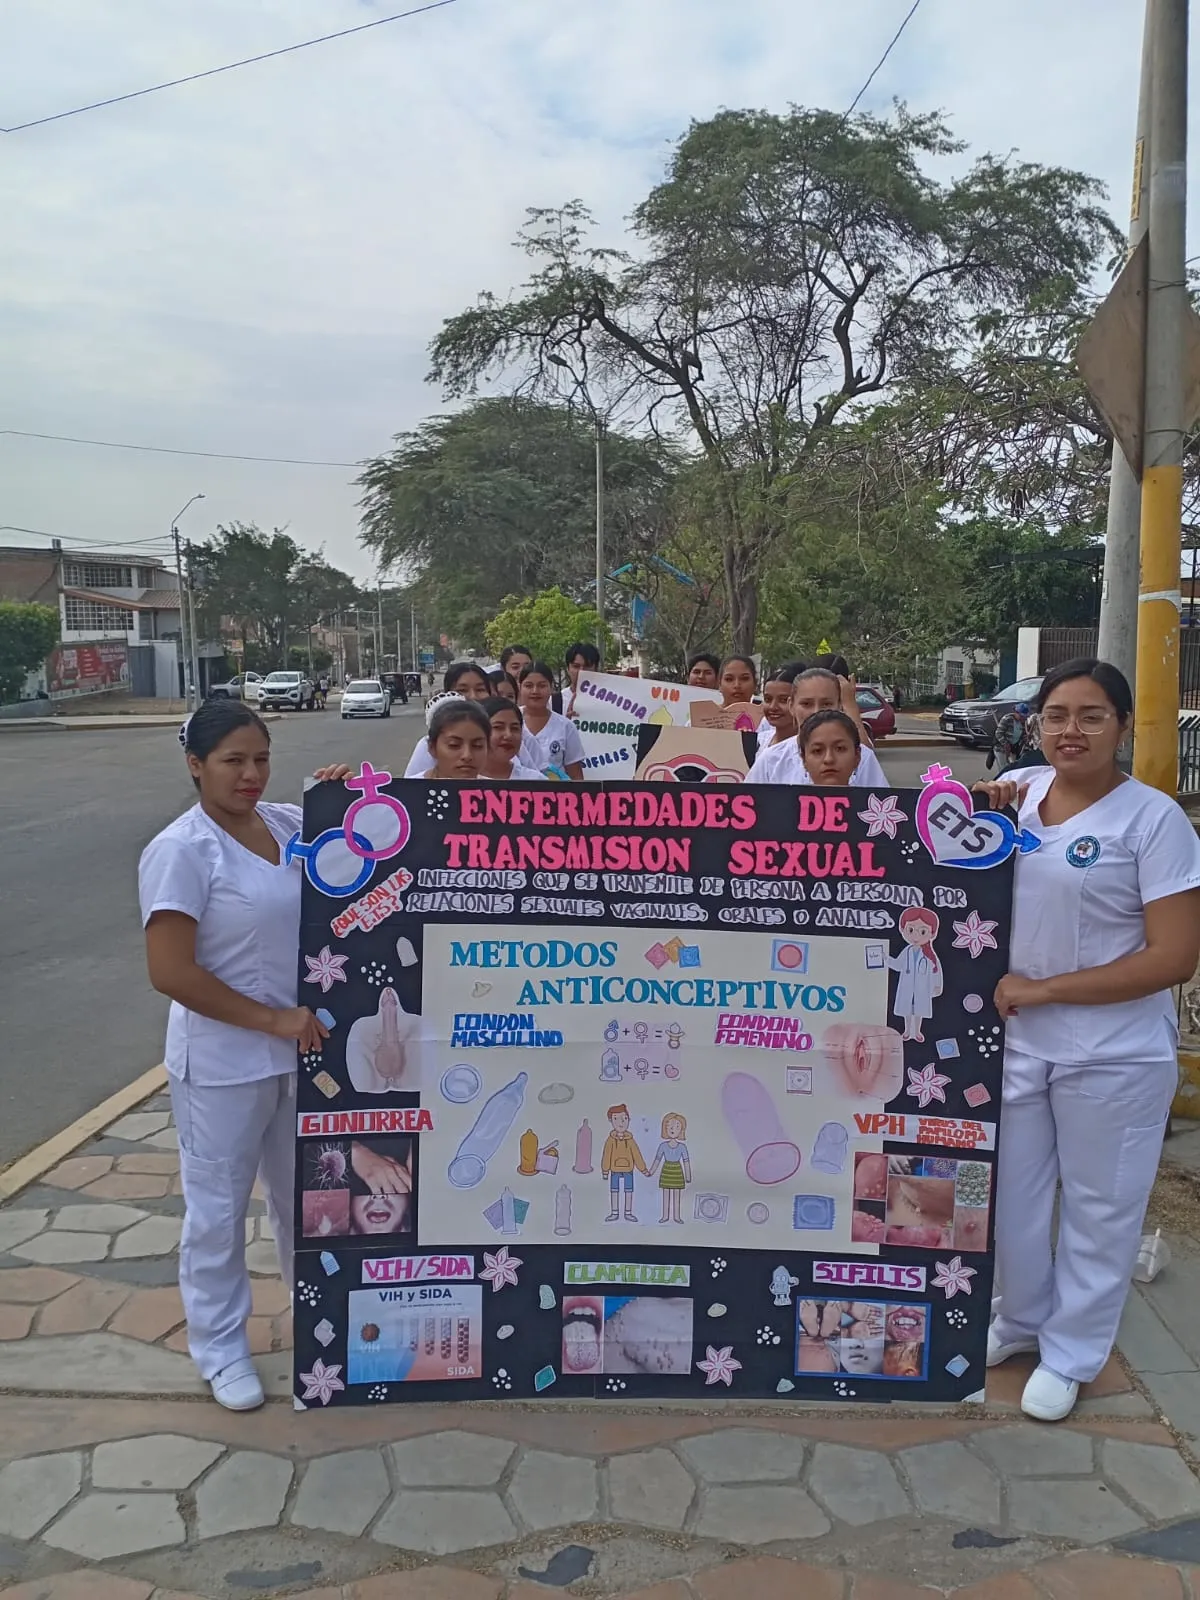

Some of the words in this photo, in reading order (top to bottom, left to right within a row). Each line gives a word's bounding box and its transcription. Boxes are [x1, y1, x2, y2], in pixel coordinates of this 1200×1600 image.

[580, 680, 647, 720] CLAMIDIA
[458, 789, 757, 831] ENFERMEDADES
[799, 794, 850, 833] DE
[928, 801, 993, 854] ETS
[444, 833, 691, 873] TRANSMISION
[728, 840, 886, 878] SEXUAL
[359, 885, 391, 912] SON
[387, 868, 413, 892] LAS
[419, 869, 524, 889] INFECCIONES
[533, 872, 567, 890] QUE
[575, 873, 597, 890] SE
[602, 874, 692, 894] TRANSMITE
[701, 877, 723, 895] DE
[732, 879, 804, 900] PERSONA
[812, 882, 827, 899] A
[840, 882, 922, 906] PERSONA
[935, 886, 966, 906] POR
[408, 891, 514, 913] RELACIONES
[521, 896, 604, 916] SEXUALES
[611, 902, 708, 921] VAGINALES,
[720, 907, 785, 924] ORALES
[794, 910, 808, 924] O
[816, 908, 894, 928] ANALES.
[449, 940, 618, 969] METODOS
[516, 975, 847, 1013] ANTICONCEPTIVOS
[454, 1013, 535, 1033] CONDON
[717, 1013, 801, 1033] CONDON
[450, 1029, 564, 1048] MASCULINO
[714, 1029, 814, 1051] FEMENINO
[301, 1108, 434, 1135] GONORREA
[363, 1256, 472, 1282] VIH/SIDA
[566, 1263, 689, 1284] CLAMIDIA
[815, 1262, 922, 1289] SIFILIS
[379, 1291, 403, 1302] VIH
[407, 1291, 416, 1302] y
[419, 1288, 453, 1300] SIDA
[447, 1366, 475, 1376] SIDA
